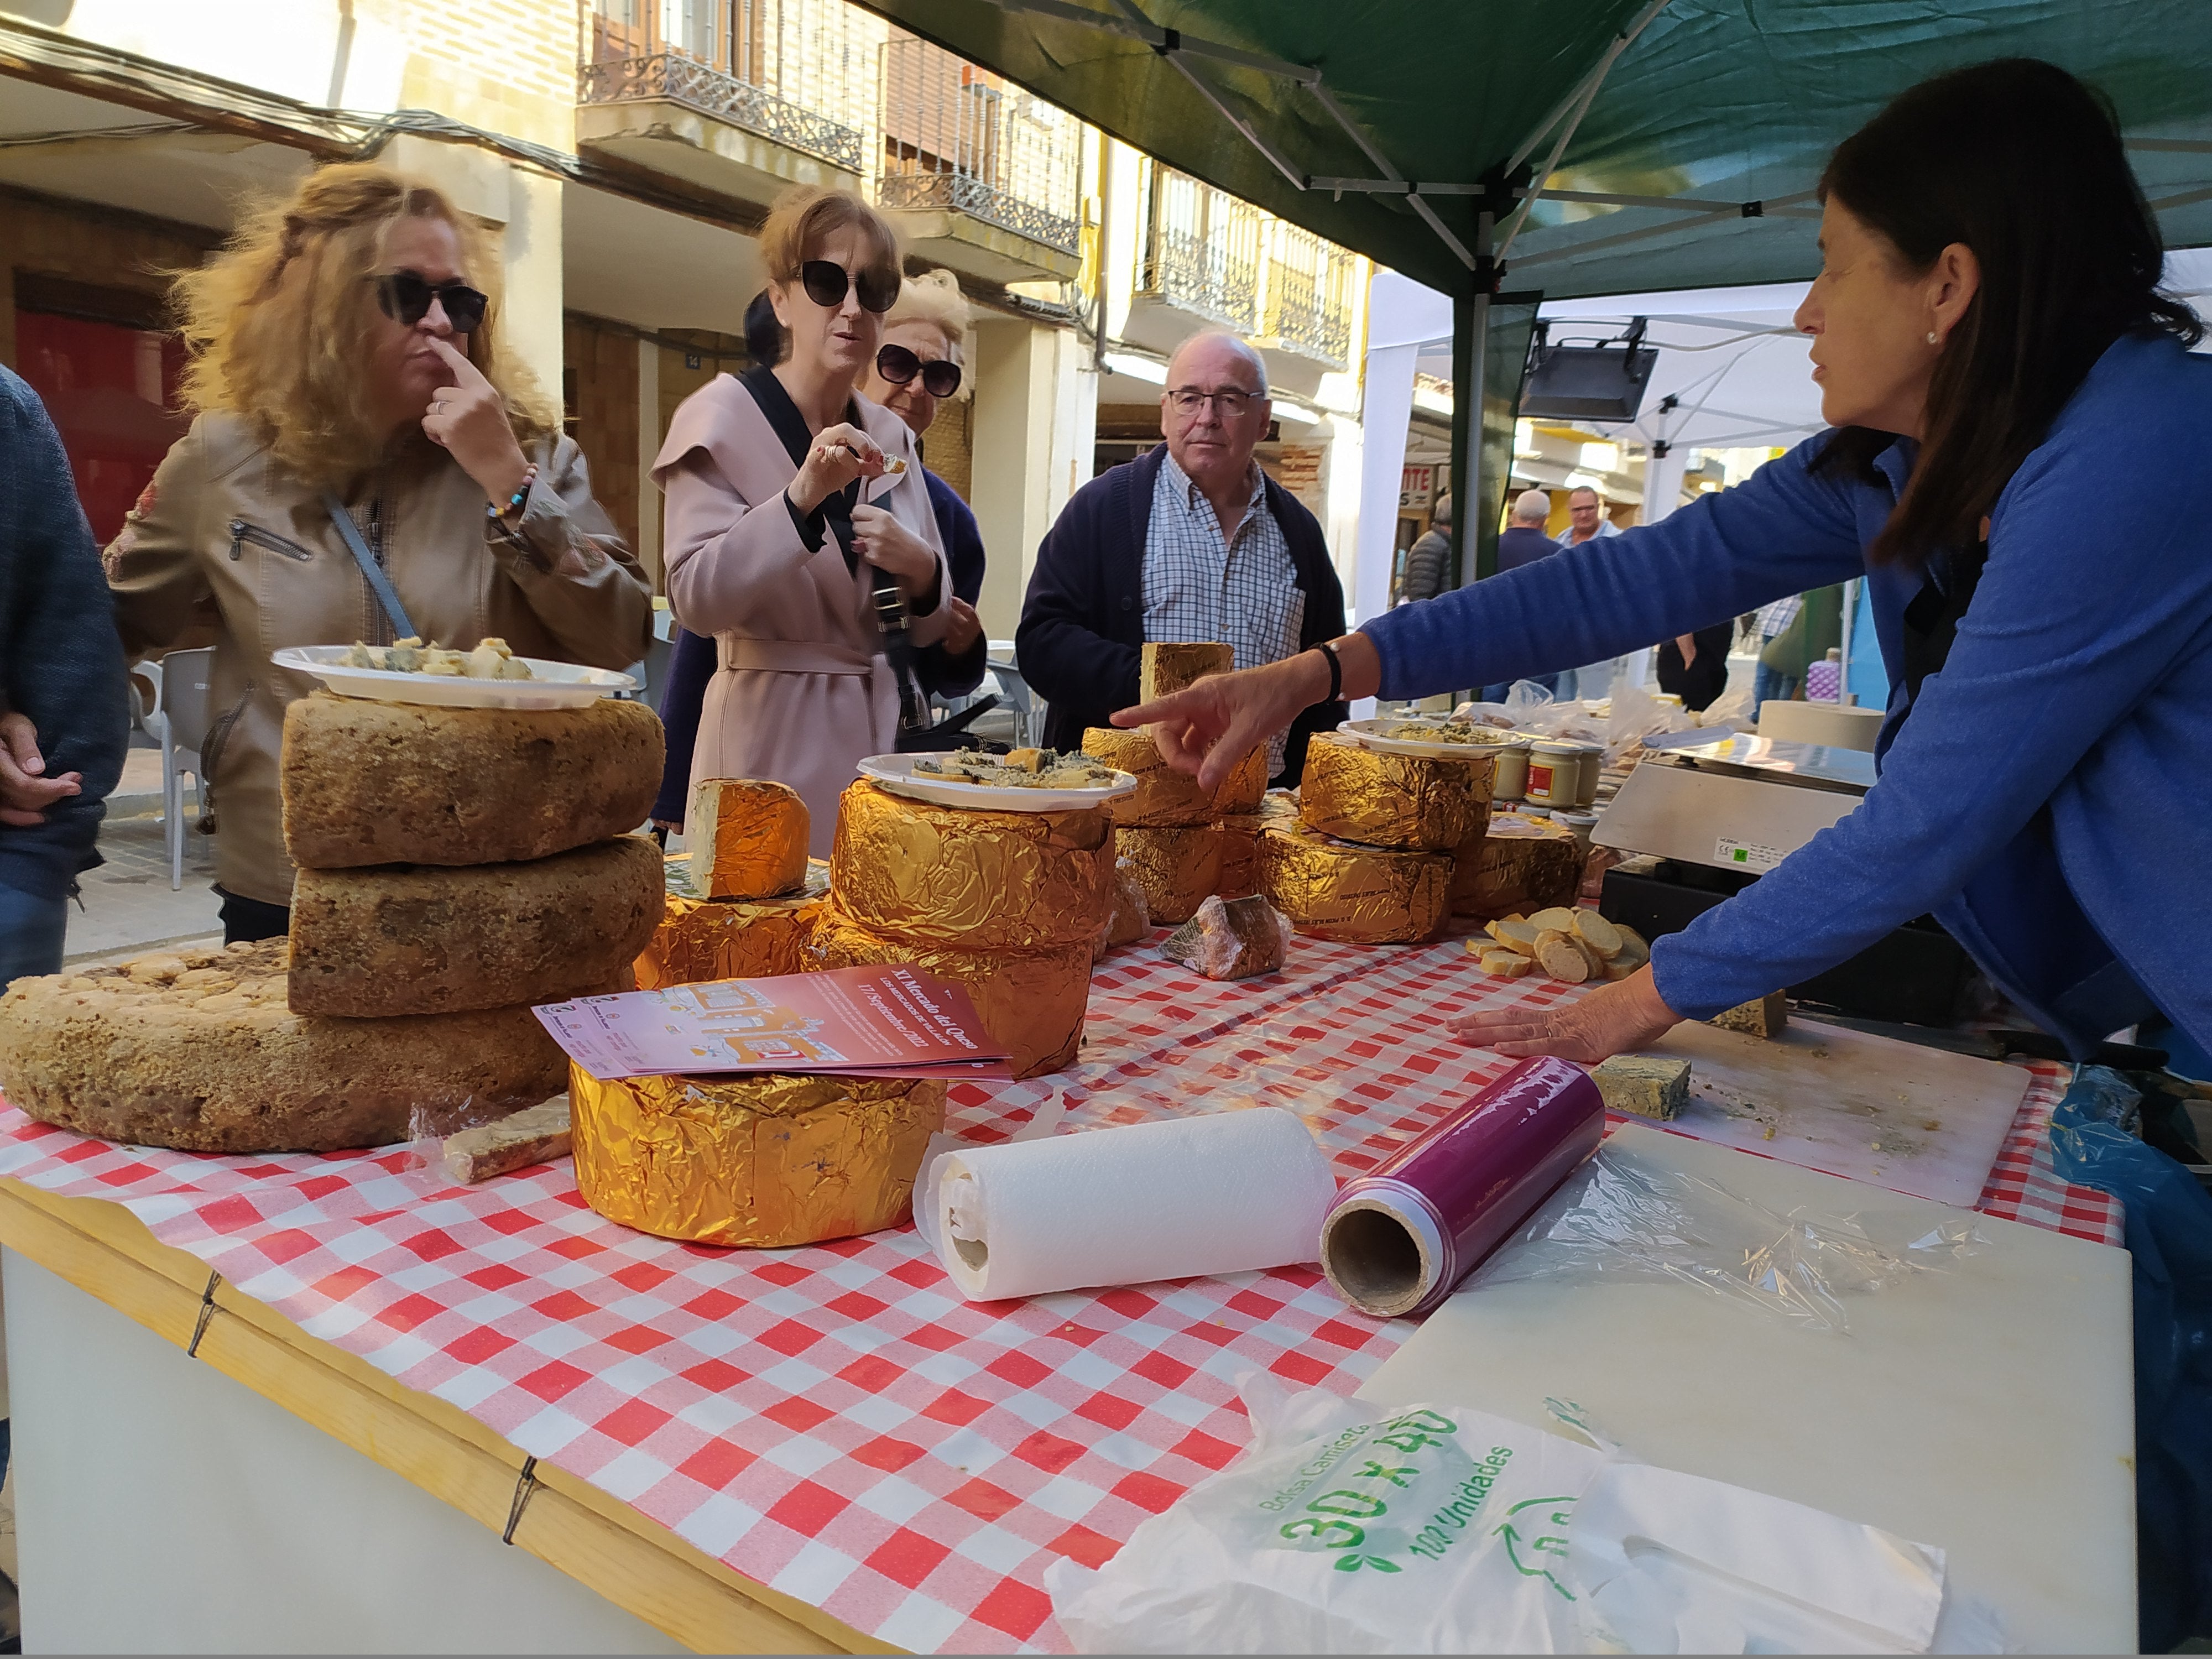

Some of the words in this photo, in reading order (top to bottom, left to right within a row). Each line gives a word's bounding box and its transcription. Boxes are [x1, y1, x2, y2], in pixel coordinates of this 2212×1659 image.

[891, 969, 913, 980] XI
[879, 977, 894, 988] LOS
[889, 987, 920, 1015] MERCADOS
[914, 1015, 928, 1023] DE
[900, 979, 940, 1014] Mercado
[933, 1015, 957, 1027] del
[946, 1027, 978, 1049] Queso
[1259, 1479, 1314, 1511] Bolsa
[1280, 1490, 1388, 1548] 30
[1372, 1409, 1458, 1453] 40
[1433, 1445, 1514, 1528] Unidades
